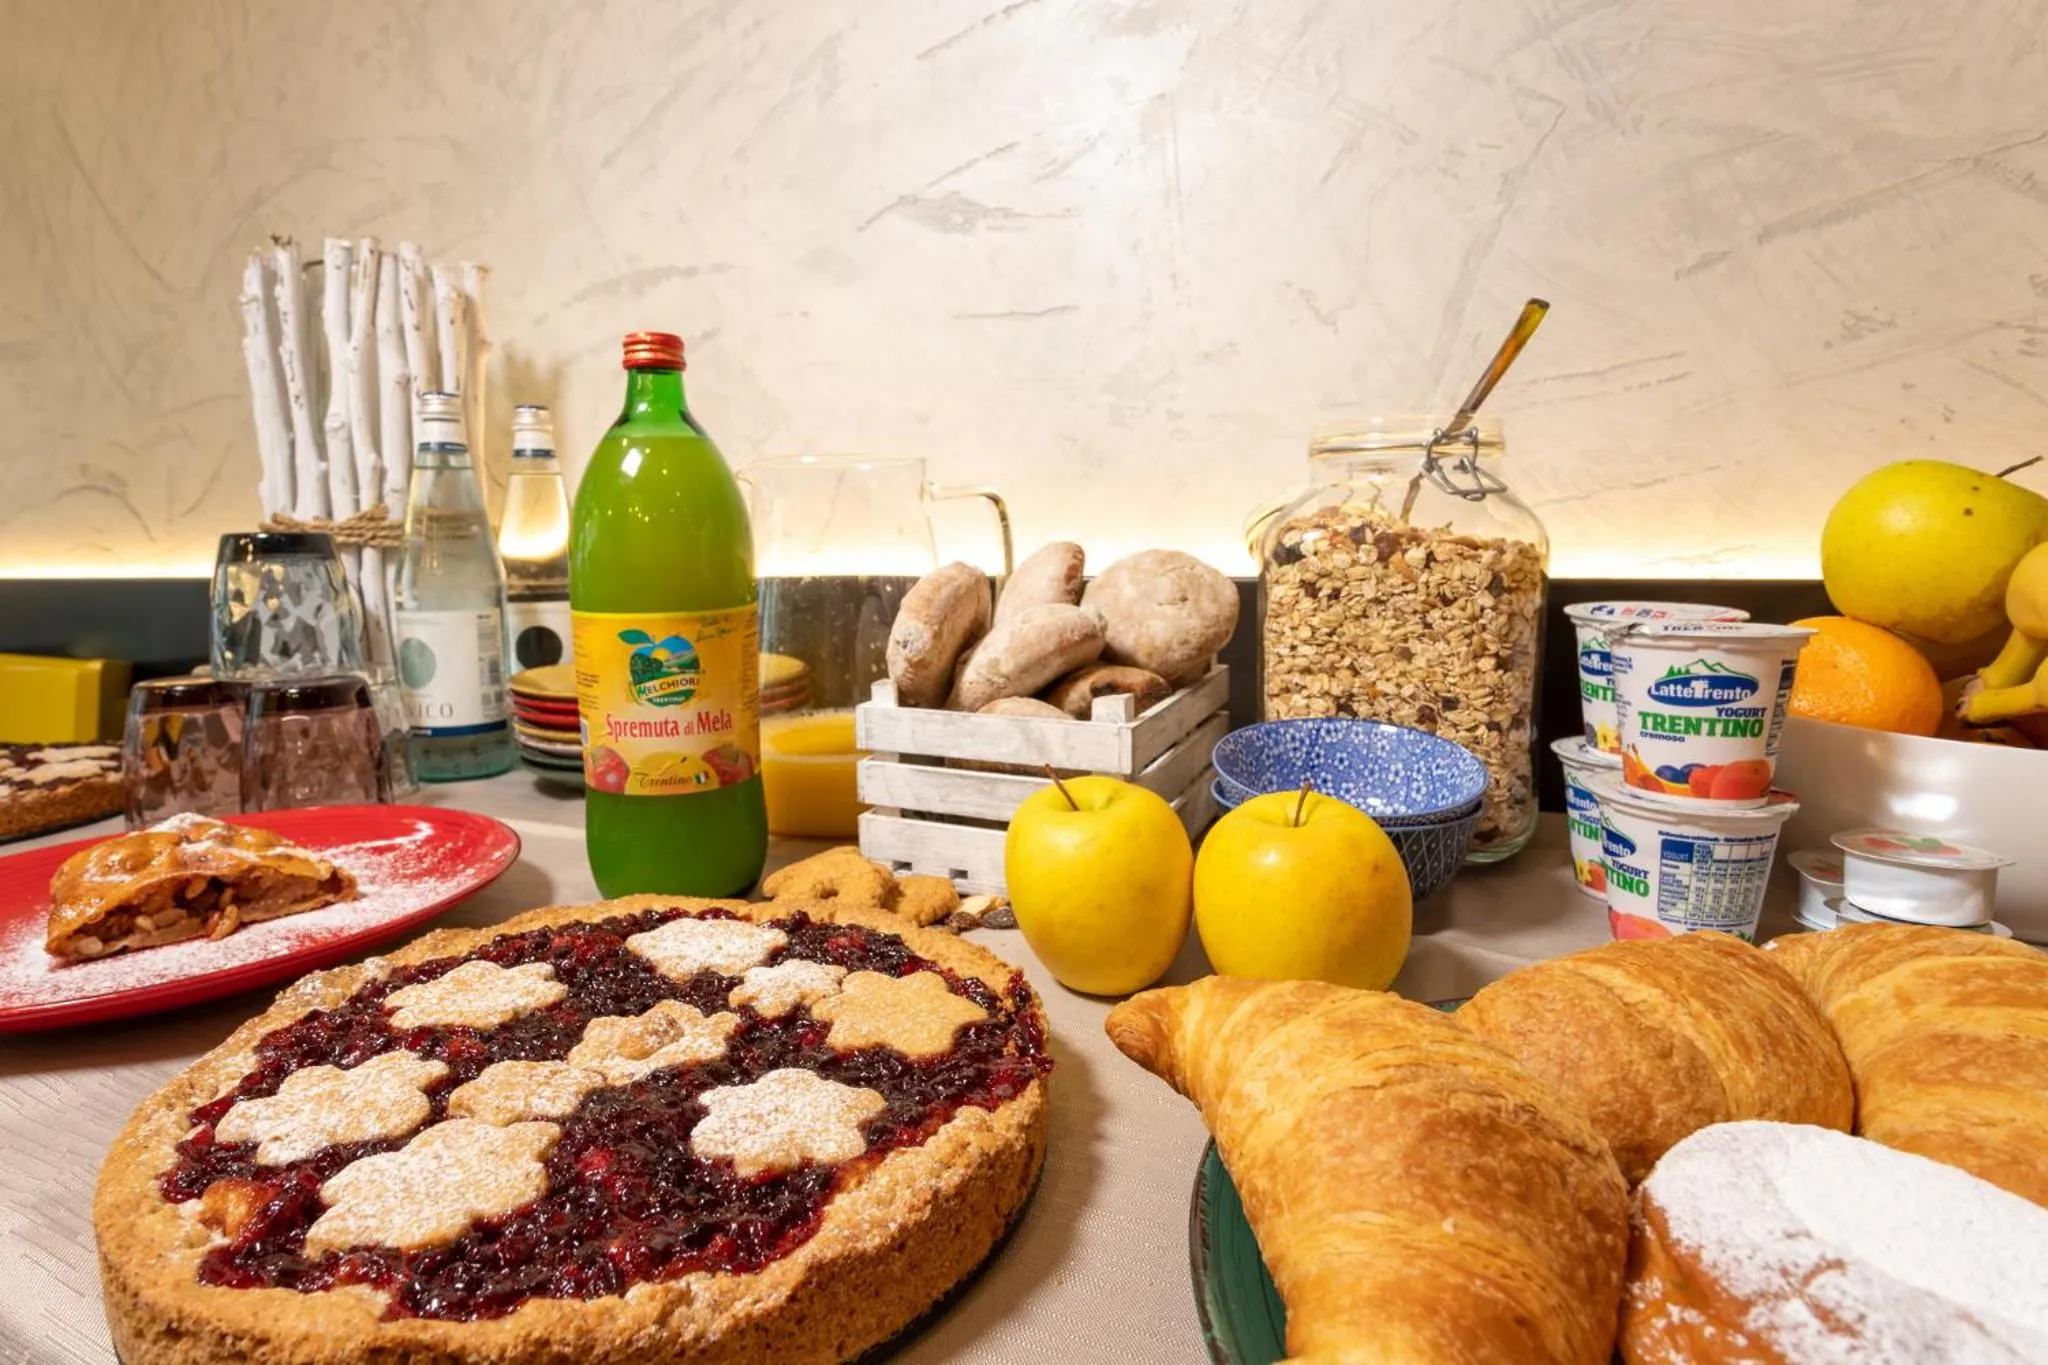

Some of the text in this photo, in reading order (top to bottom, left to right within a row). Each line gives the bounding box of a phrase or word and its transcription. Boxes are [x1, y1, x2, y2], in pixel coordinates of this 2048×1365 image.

[1650, 679, 1752, 700] LatteTrento
[1716, 707, 1767, 718] YOGURT
[606, 707, 733, 742] Spremuta di Mela
[1638, 711, 1764, 737] TRENTINO
[1639, 731, 1686, 742] cremoso
[634, 771, 693, 787] Trentino
[1611, 859, 1649, 879] YOGURT
